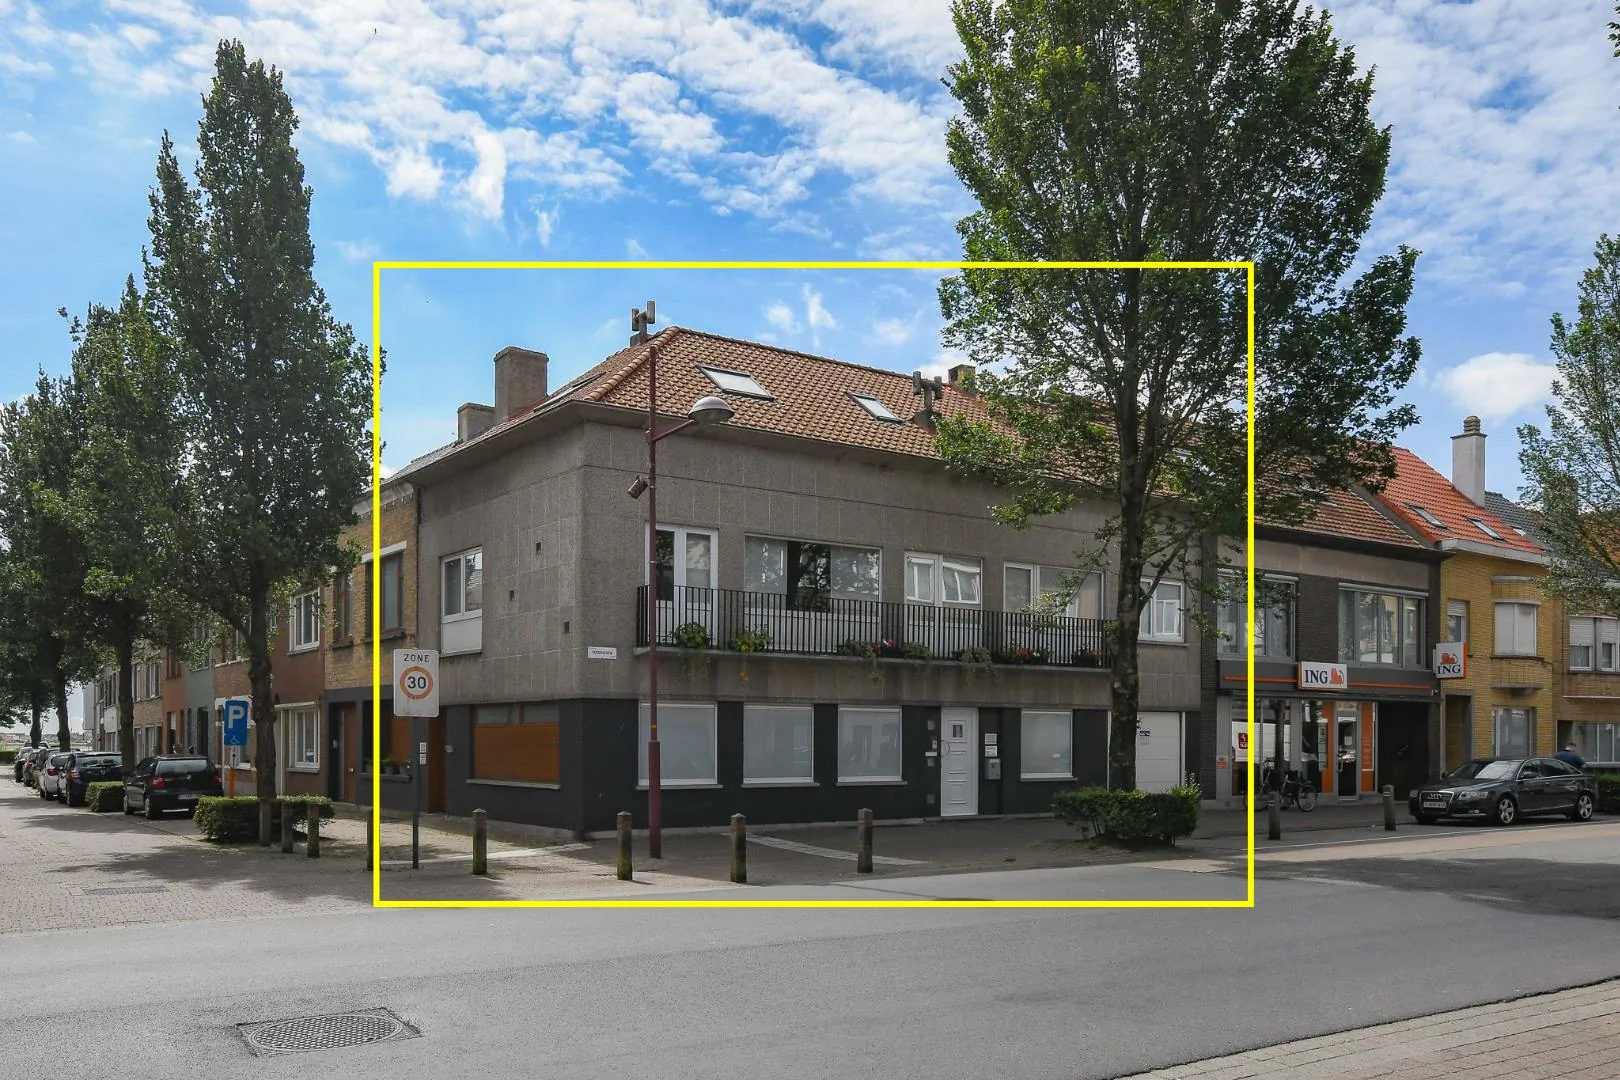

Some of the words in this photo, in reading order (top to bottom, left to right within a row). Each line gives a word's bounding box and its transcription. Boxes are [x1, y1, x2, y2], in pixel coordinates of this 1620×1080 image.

[404, 654, 430, 663] ZONE
[1437, 664, 1461, 674] ING
[407, 676, 427, 689] 30
[1304, 669, 1328, 684] ING
[228, 705, 245, 729] P
